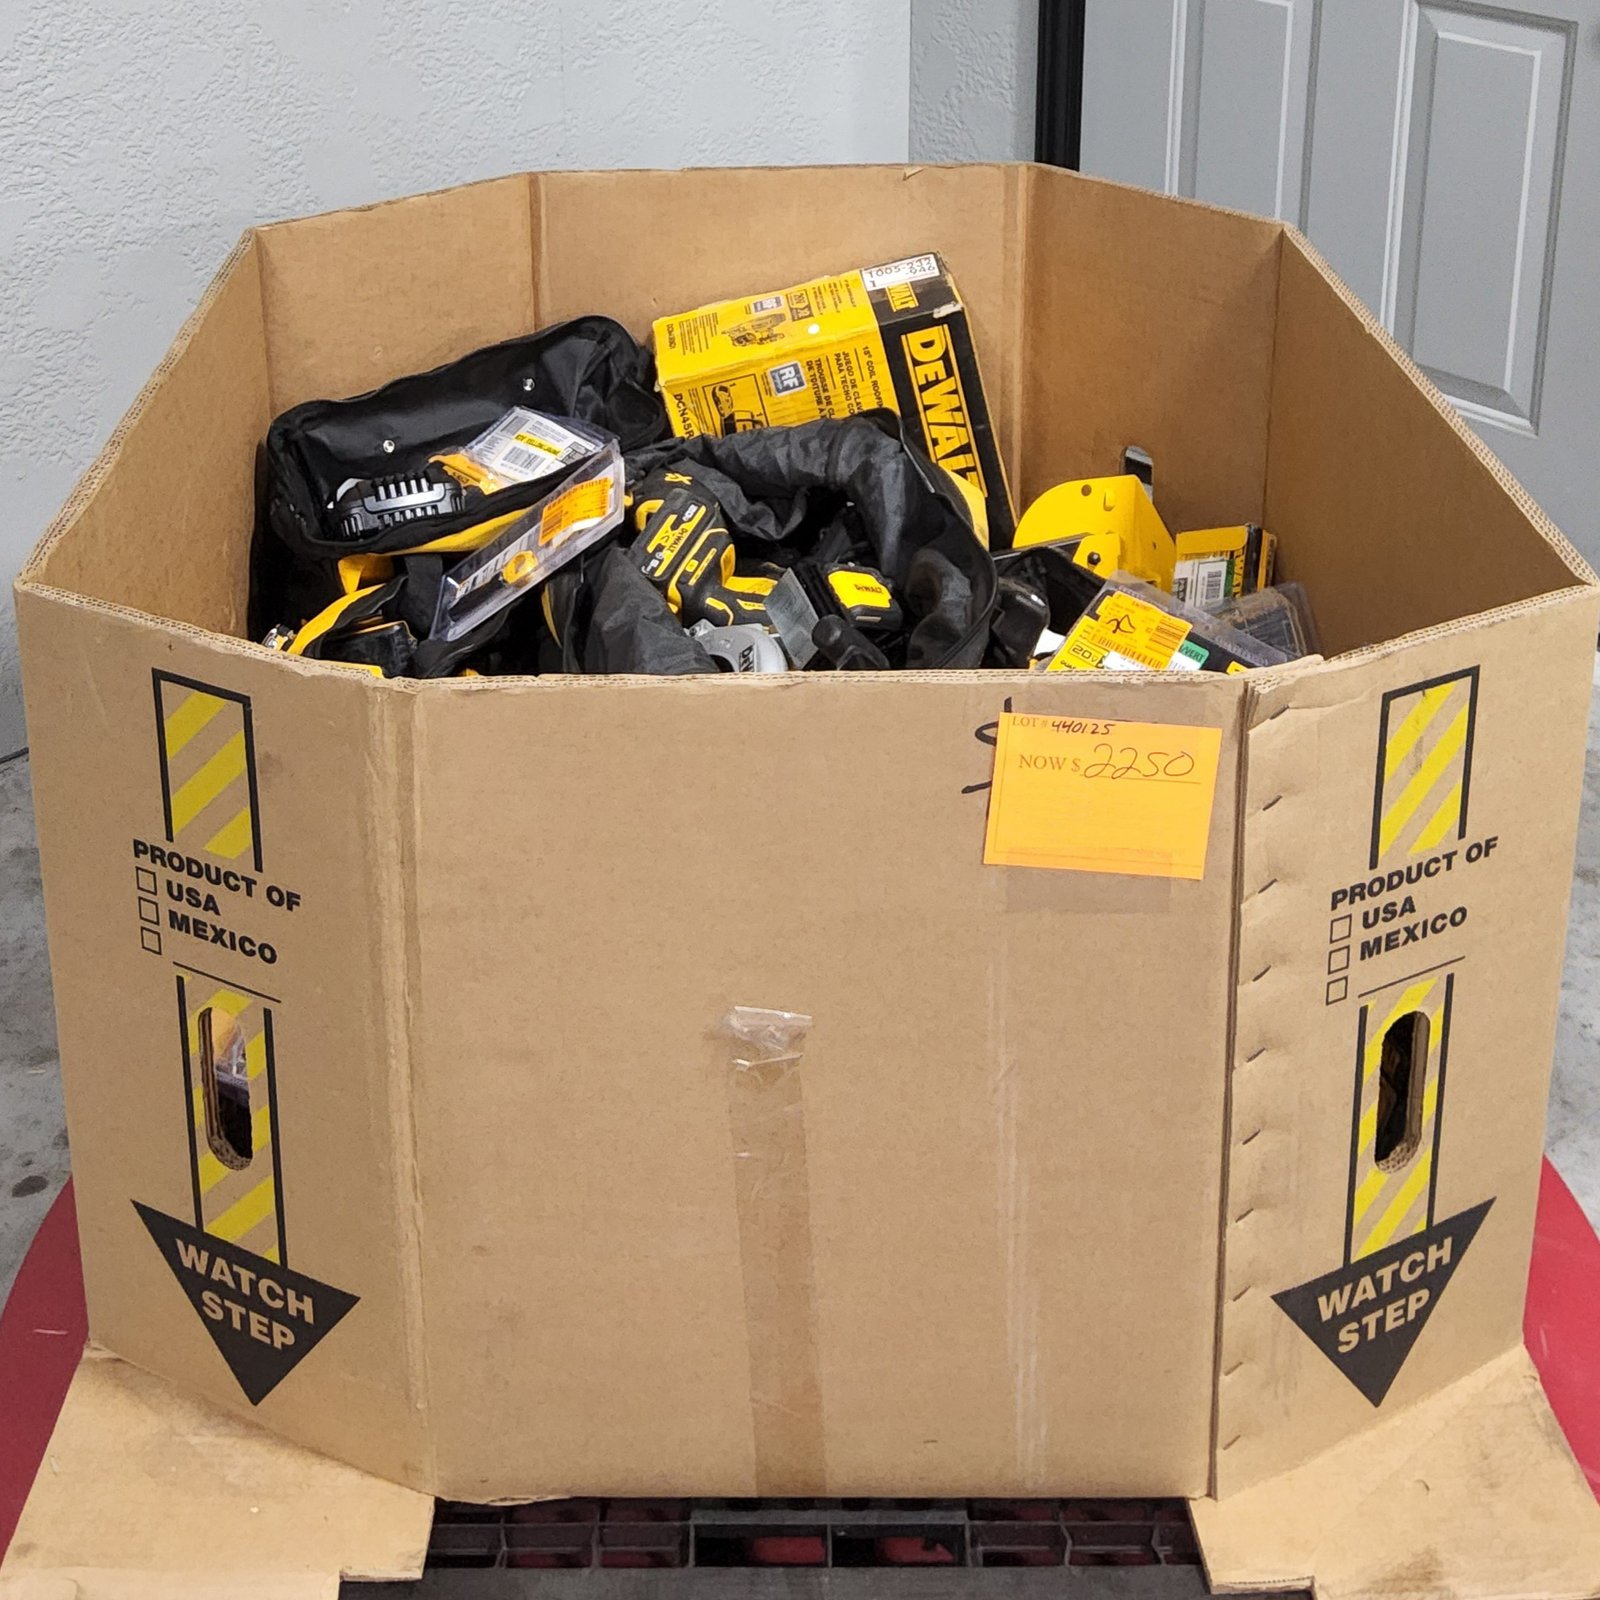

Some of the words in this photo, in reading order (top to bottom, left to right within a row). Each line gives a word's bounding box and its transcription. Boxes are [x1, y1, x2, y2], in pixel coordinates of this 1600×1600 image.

[805, 359, 815, 373] DE
[814, 357, 830, 394] TROUSSE
[824, 394, 833, 407] DE
[834, 352, 845, 374] PARA
[842, 351, 855, 377] JUEGO
[849, 378, 858, 390] DE
[866, 360, 877, 380] COIL
[809, 373, 824, 407] TOITURE
[839, 375, 852, 402] TECHO
[1012, 715, 1037, 727] LOT
[1051, 719, 1116, 736] 440125
[1018, 753, 1067, 771] NOW
[132, 838, 258, 898] PRODUCT
[266, 885, 302, 912] OF
[1331, 850, 1459, 912] PRODUCT
[1465, 836, 1499, 863] OF
[166, 879, 221, 916] USA
[1361, 895, 1417, 930] USA
[168, 909, 278, 965] MEXICO
[1359, 906, 1468, 962] MEXICO
[175, 1237, 316, 1326] WATCH
[1317, 1235, 1454, 1324] WATCH
[201, 1289, 296, 1351] STEP
[1336, 1287, 1431, 1354] STEP
